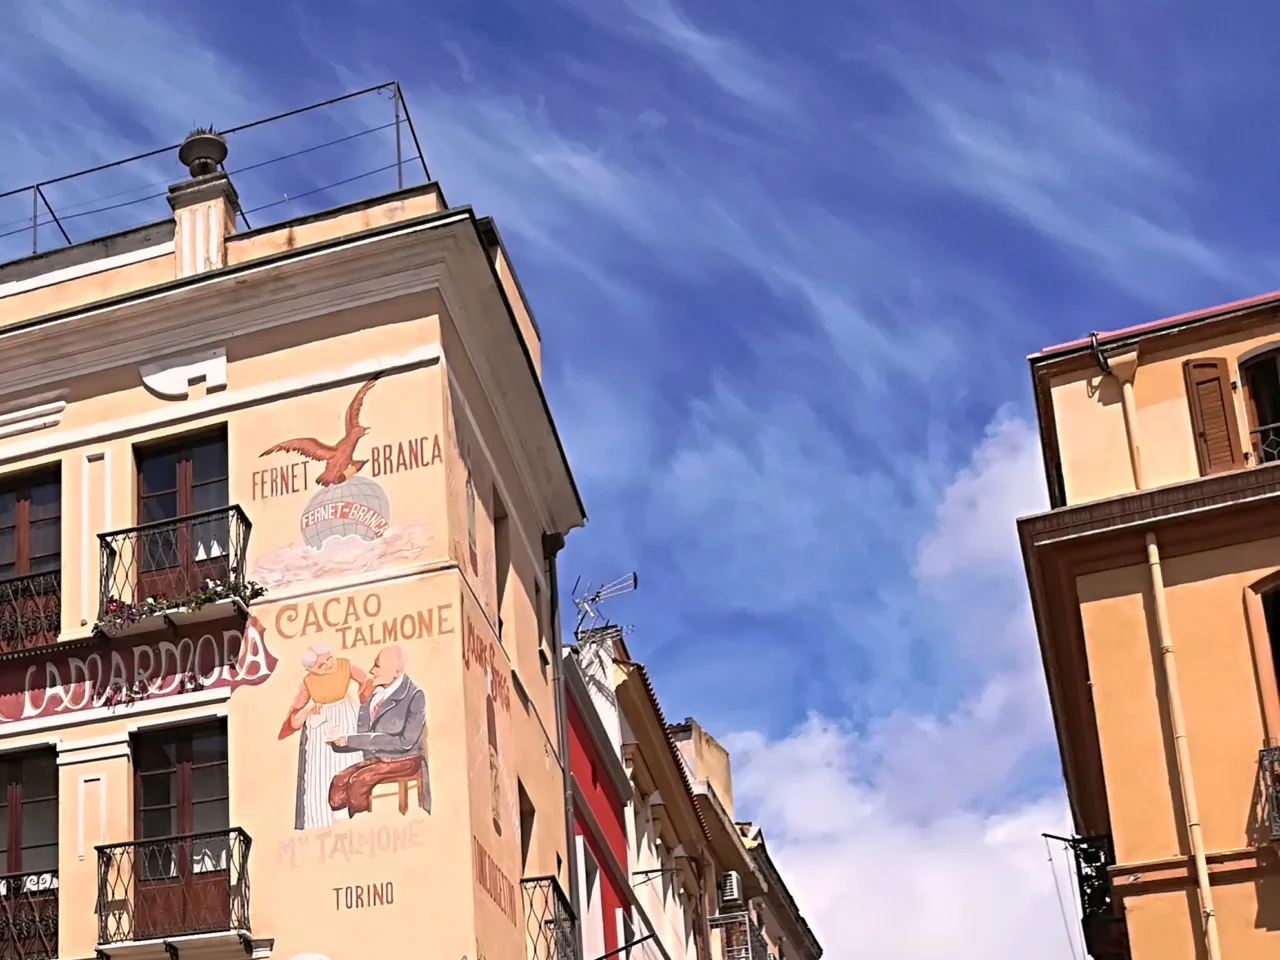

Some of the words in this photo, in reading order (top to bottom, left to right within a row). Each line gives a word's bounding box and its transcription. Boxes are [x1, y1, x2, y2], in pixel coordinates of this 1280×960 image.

[251, 460, 311, 502] FERNET
[371, 433, 443, 478] BRANCA
[274, 592, 383, 640] CACAO
[335, 602, 456, 651] TALMONE
[20, 624, 272, 719] LAMARMORA
[315, 820, 425, 866] TALMONE
[332, 881, 395, 911] TORINO
